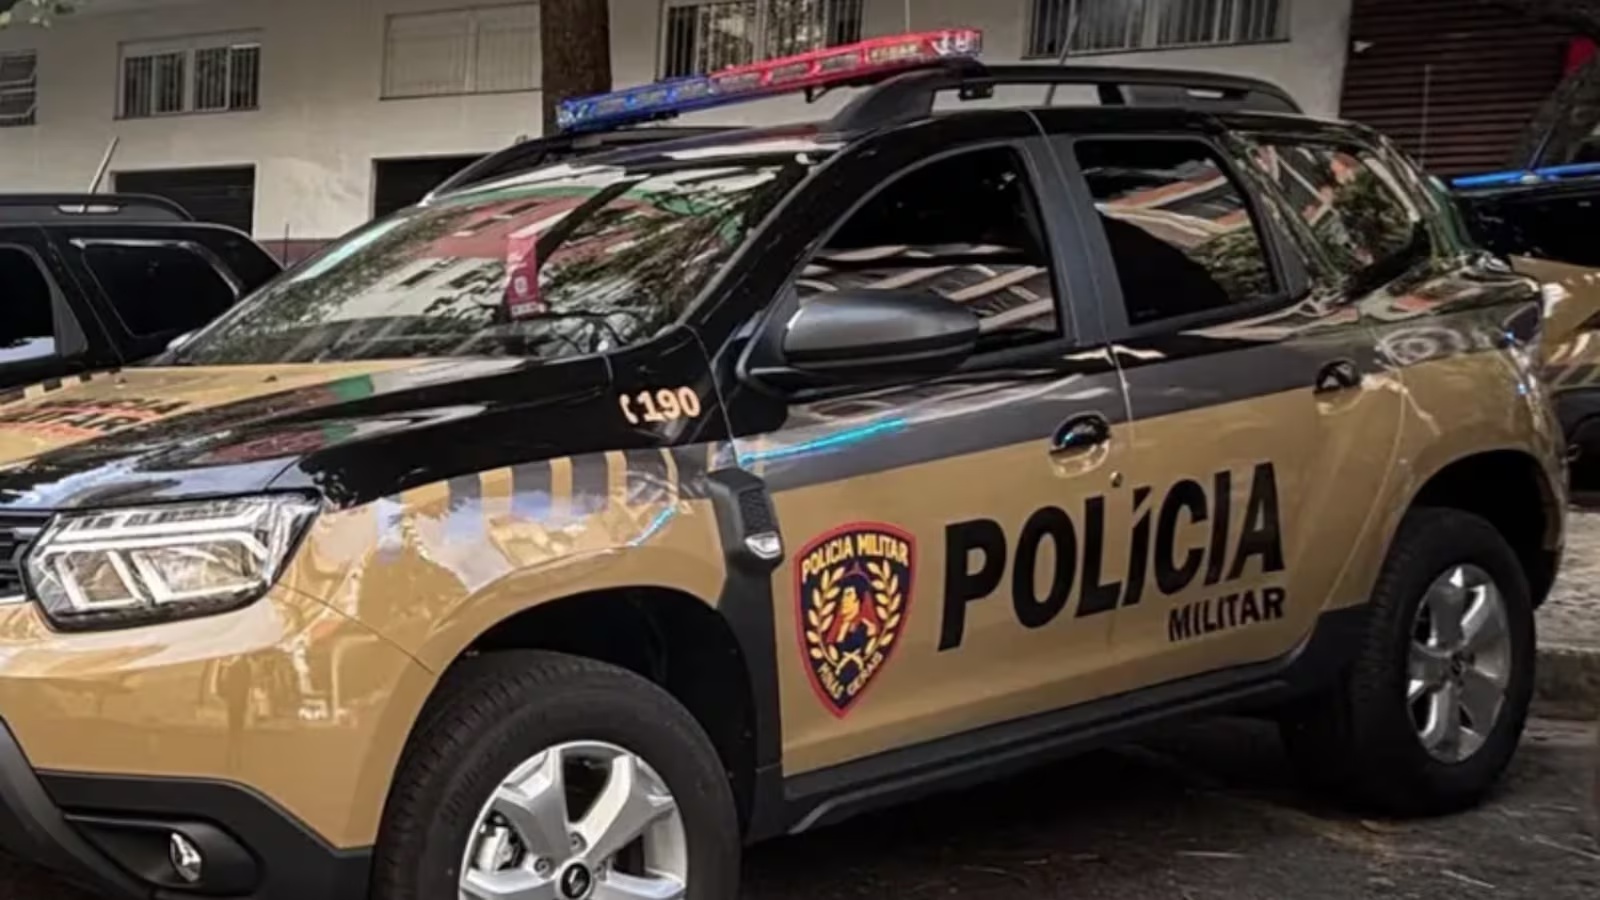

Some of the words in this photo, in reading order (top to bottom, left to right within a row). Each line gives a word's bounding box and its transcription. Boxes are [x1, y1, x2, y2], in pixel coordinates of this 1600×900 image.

[637, 386, 700, 422] 190
[857, 533, 908, 567] MILITAR
[938, 462, 1285, 651] POLÍCIA
[1168, 587, 1286, 642] MILITAR
